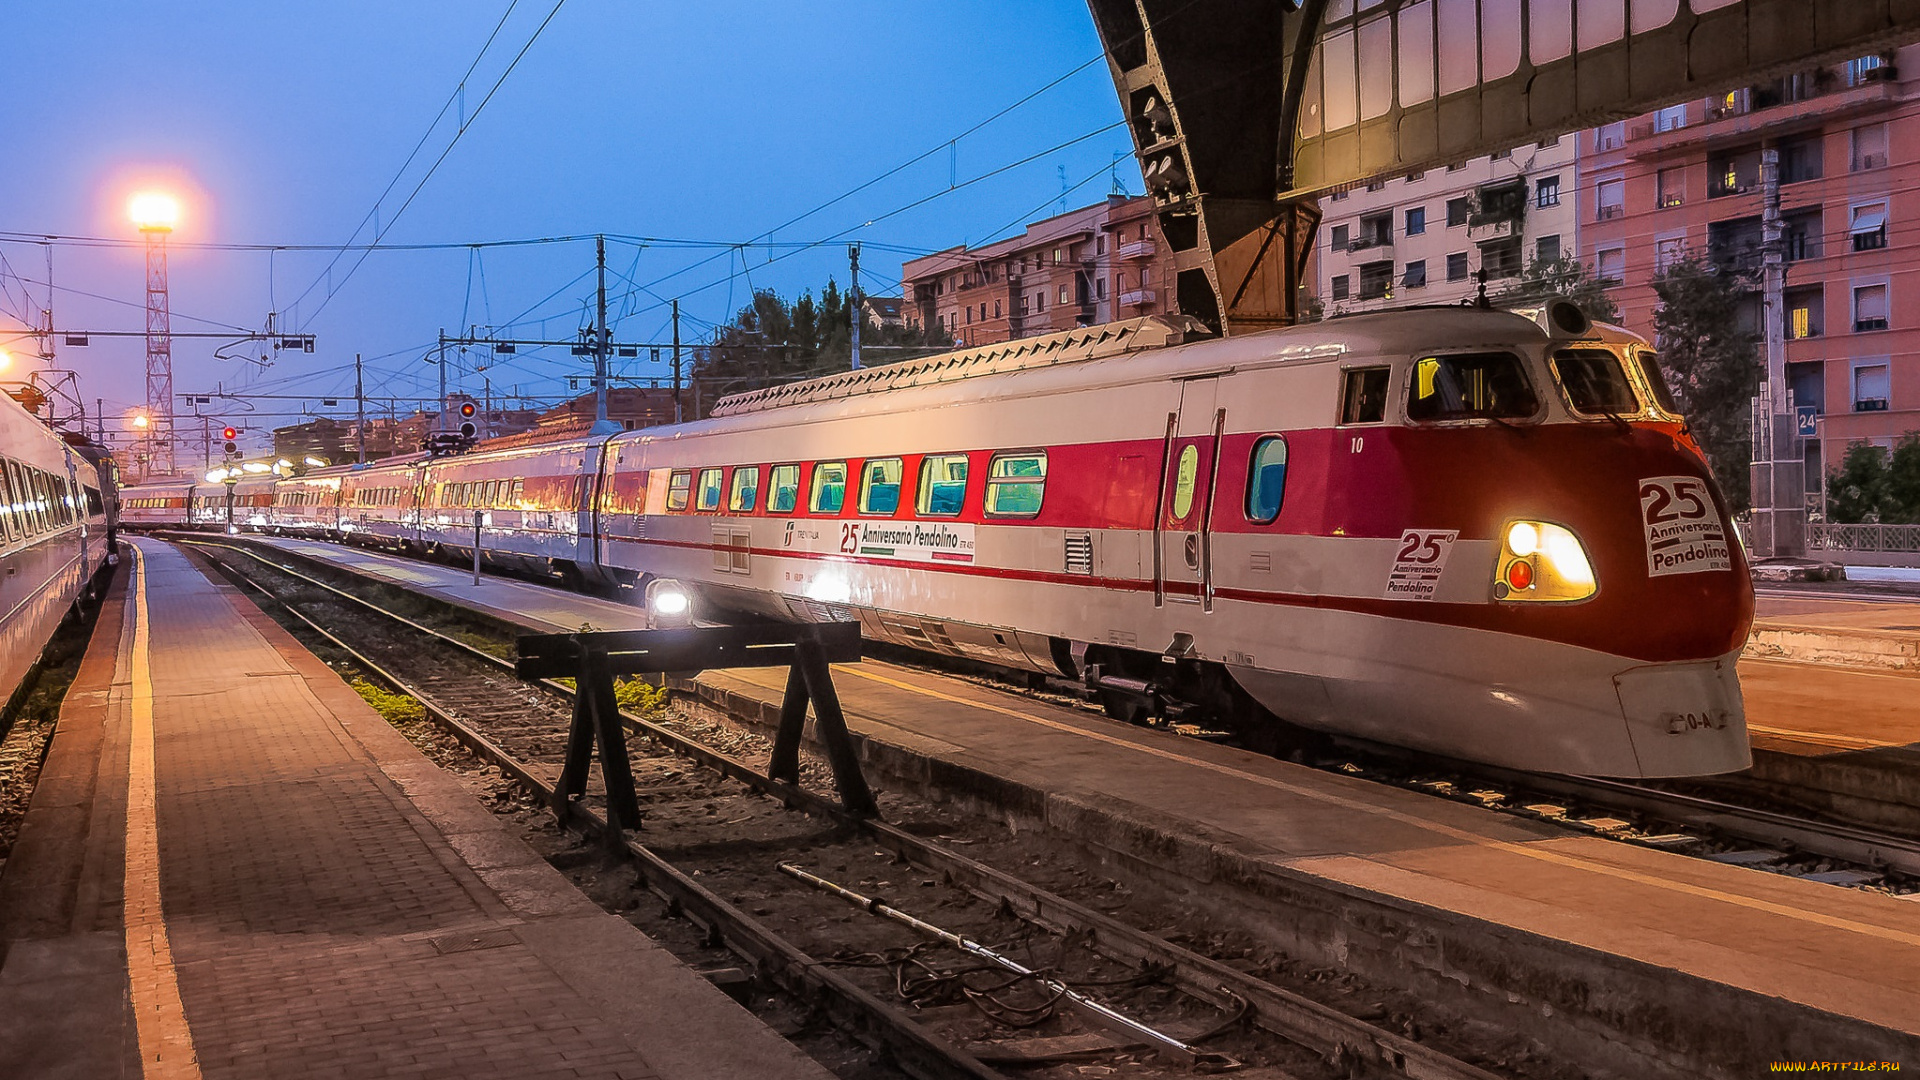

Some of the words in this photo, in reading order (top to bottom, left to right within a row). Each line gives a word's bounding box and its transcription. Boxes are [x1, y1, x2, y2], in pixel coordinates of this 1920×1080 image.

[1799, 414, 1815, 428] 24
[1351, 437, 1364, 454] 10
[862, 523, 912, 545] Anniversario
[913, 524, 958, 548] Pendolino
[1649, 521, 1721, 541] Anniversario
[1652, 543, 1728, 571] Pendolino
[1393, 564, 1442, 574] Anniversario
[1387, 581, 1434, 593] Pendolino
